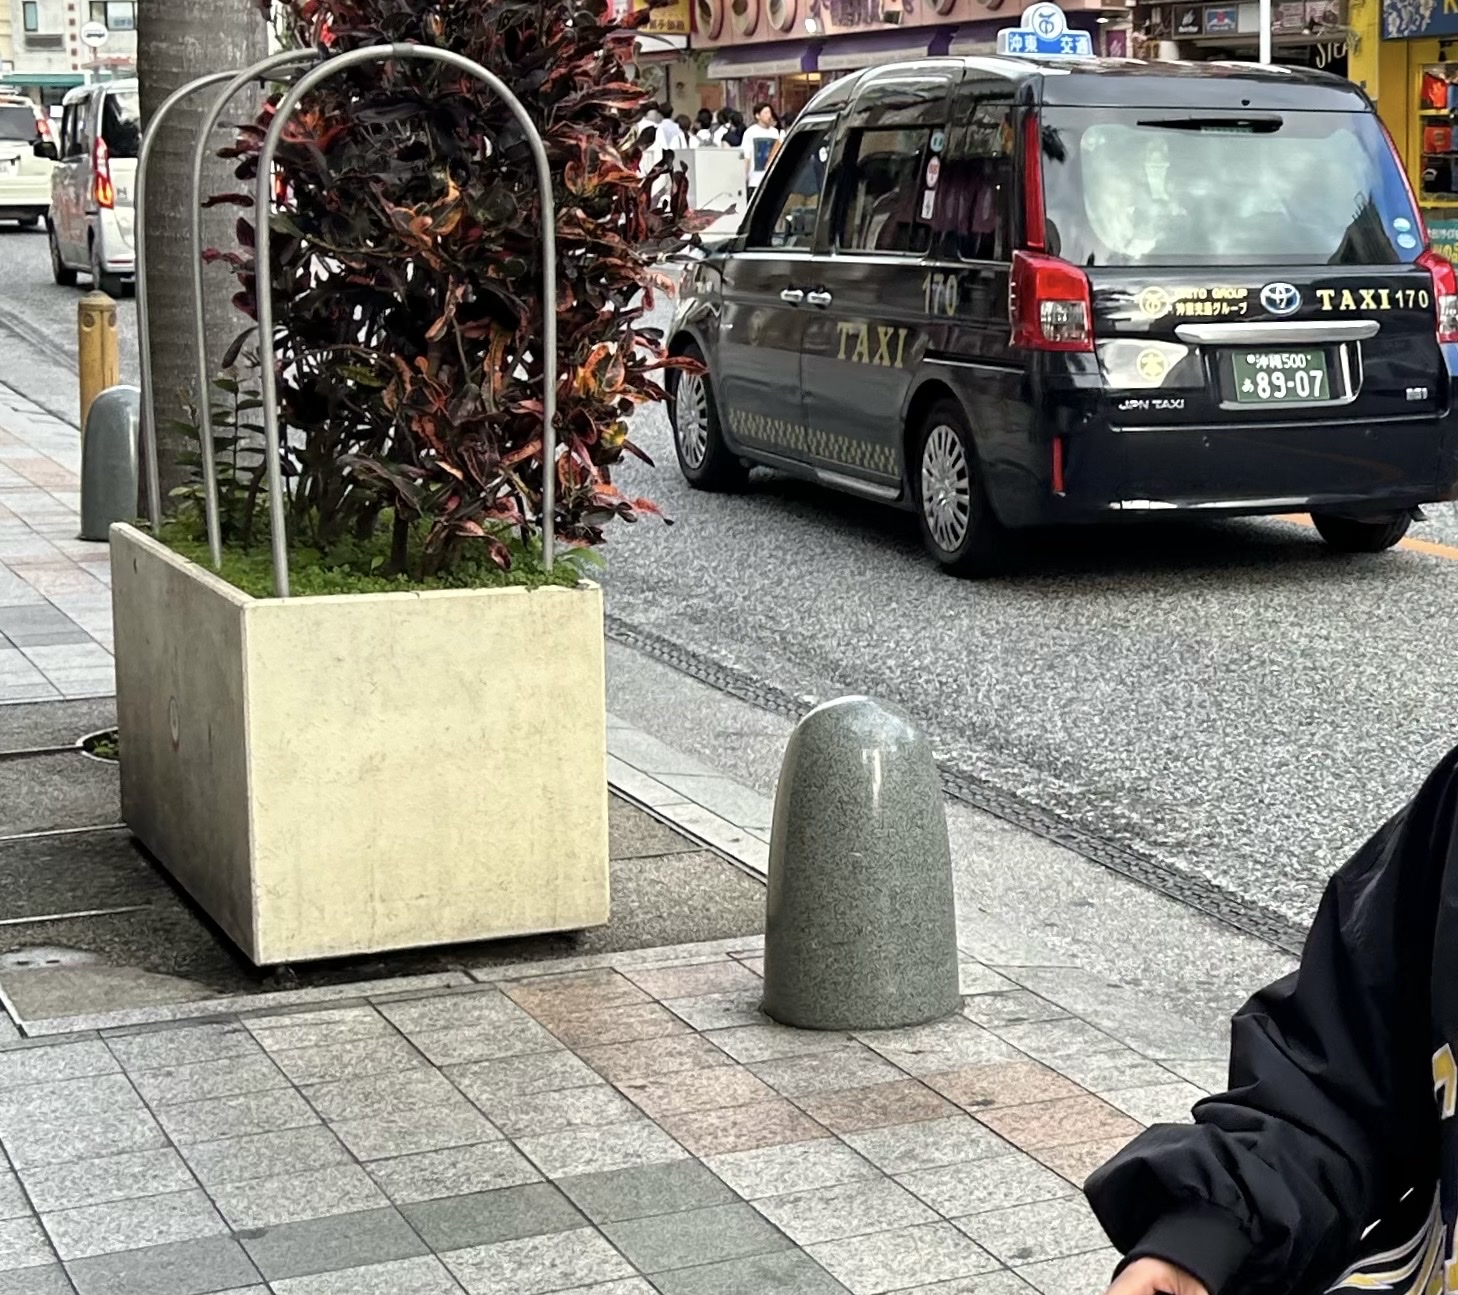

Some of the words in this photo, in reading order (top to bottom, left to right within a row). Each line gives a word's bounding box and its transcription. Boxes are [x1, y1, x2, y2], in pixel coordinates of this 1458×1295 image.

[922, 272, 957, 316] 170
[1316, 288, 1390, 311] TAXI
[1396, 289, 1429, 309] 170
[837, 322, 908, 368] TAXI
[1256, 370, 1323, 399] 89-07
[1118, 399, 1149, 410] JPN
[1151, 398, 1185, 409] TAXI
